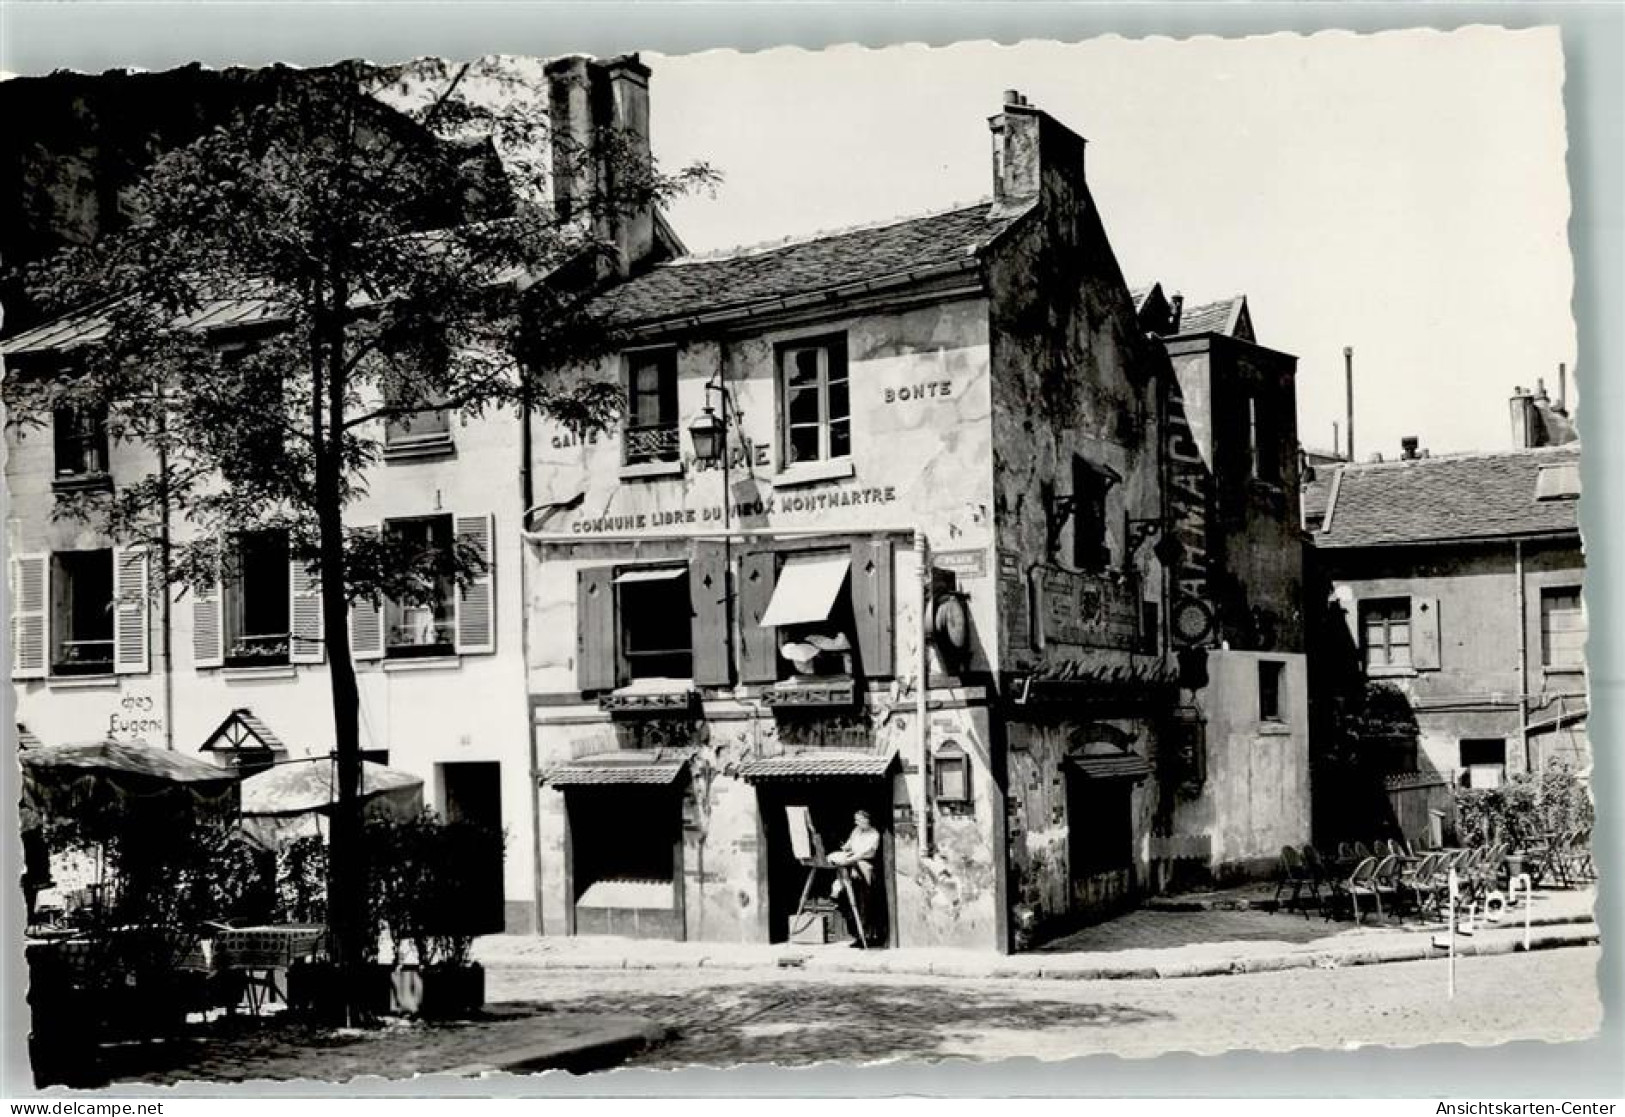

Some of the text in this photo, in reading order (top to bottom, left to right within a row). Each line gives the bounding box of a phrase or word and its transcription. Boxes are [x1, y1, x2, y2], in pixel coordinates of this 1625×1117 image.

[884, 380, 951, 404] BONTE
[572, 514, 646, 533] COMMUNE
[652, 509, 696, 527] LIBRE
[703, 505, 722, 521] DU
[782, 486, 895, 513] MONTMARTRE
